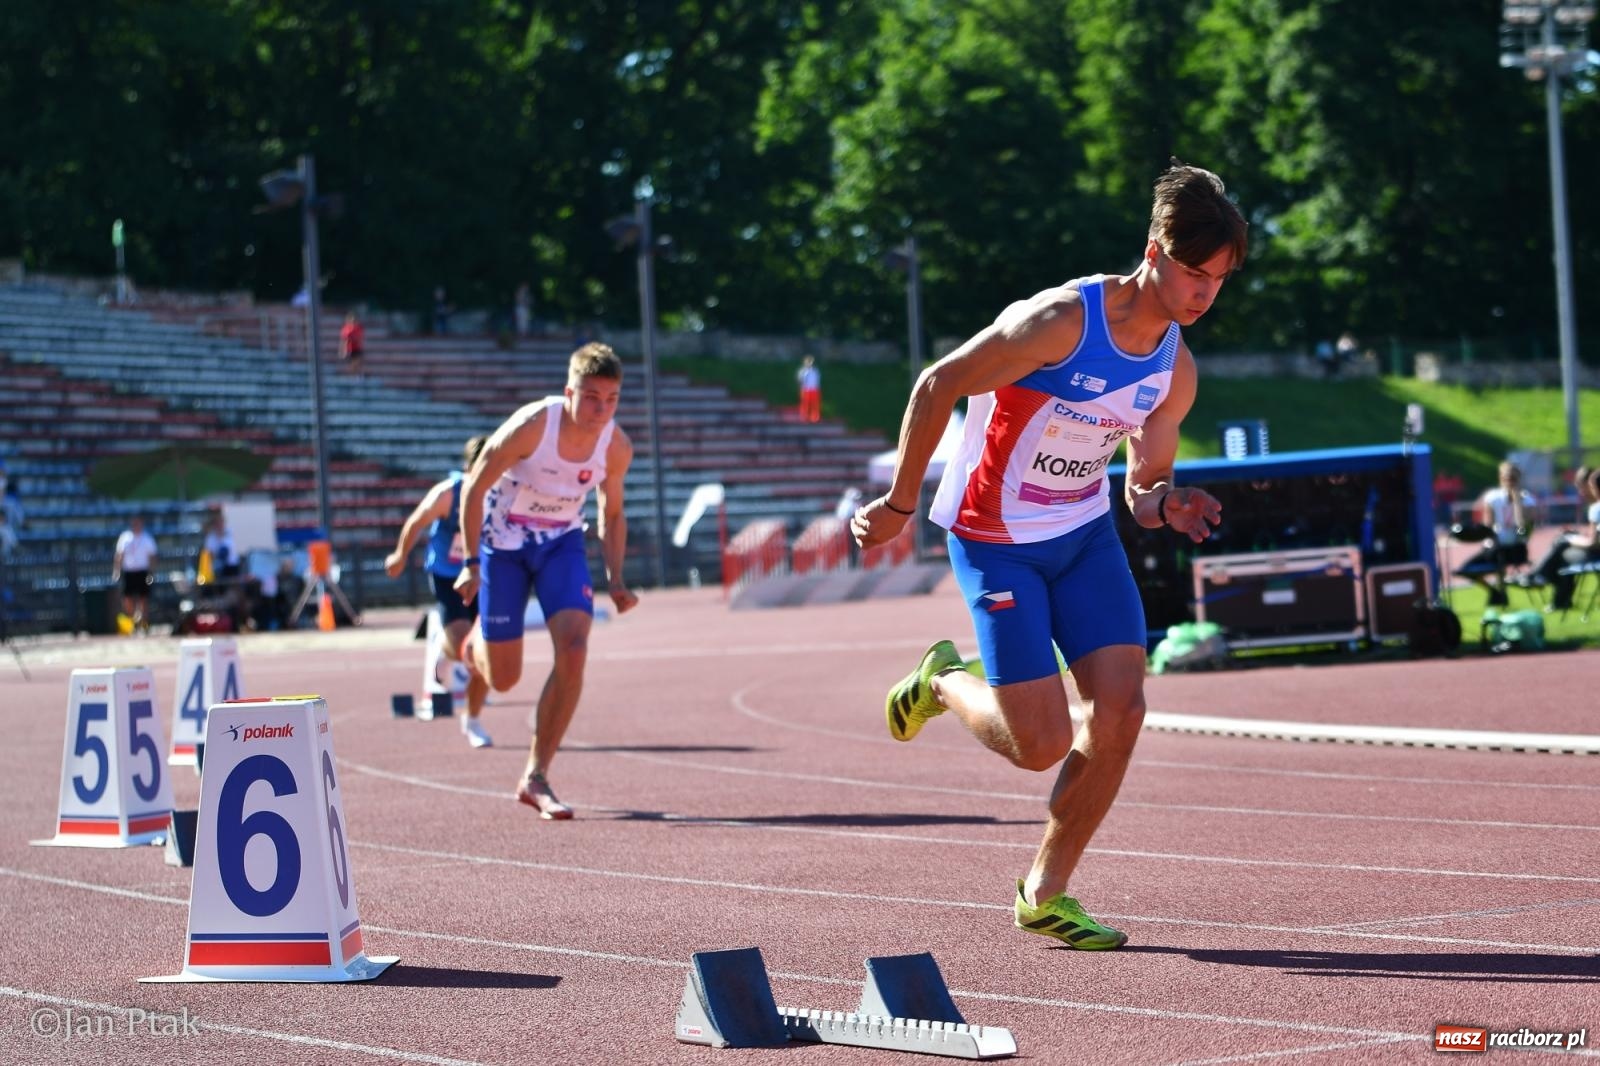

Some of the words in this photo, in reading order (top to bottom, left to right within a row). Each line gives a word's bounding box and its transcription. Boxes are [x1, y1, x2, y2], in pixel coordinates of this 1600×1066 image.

[1054, 403, 1097, 425] CZECH
[181, 664, 208, 734] 4
[243, 723, 294, 742] polanik
[72, 703, 109, 804] 5
[128, 699, 161, 802] 5
[217, 754, 302, 917] 6
[322, 750, 349, 910] 6
